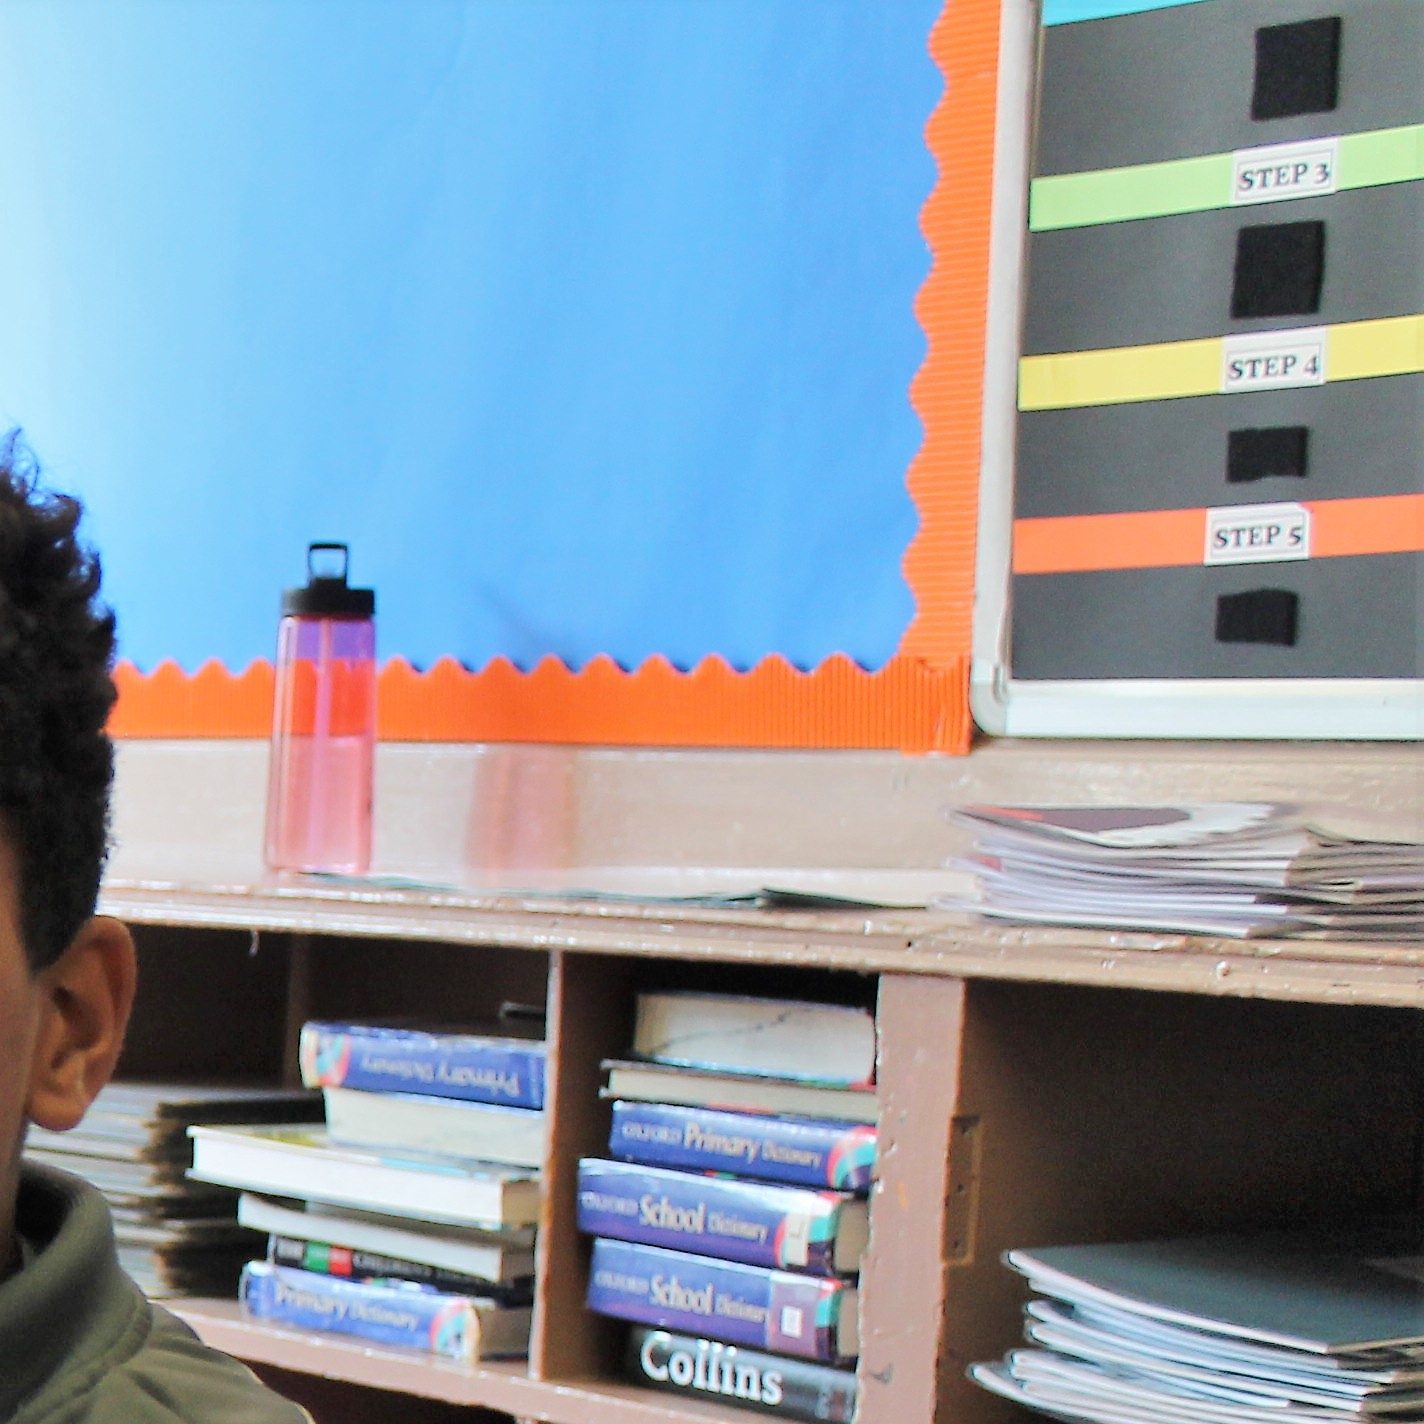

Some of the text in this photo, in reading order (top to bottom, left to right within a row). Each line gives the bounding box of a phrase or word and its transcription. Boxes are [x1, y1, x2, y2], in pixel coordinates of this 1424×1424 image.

[1238, 163, 1330, 191] STEP 3
[1229, 355, 1318, 380] STEP 4
[1214, 525, 1304, 549] STEP 5
[684, 1121, 759, 1163] Primary
[761, 1140, 822, 1169] Dictionary
[639, 1194, 705, 1234] School
[708, 1210, 768, 1244] Dictionary
[650, 1274, 714, 1317] School
[639, 1330, 784, 1406] Collins
